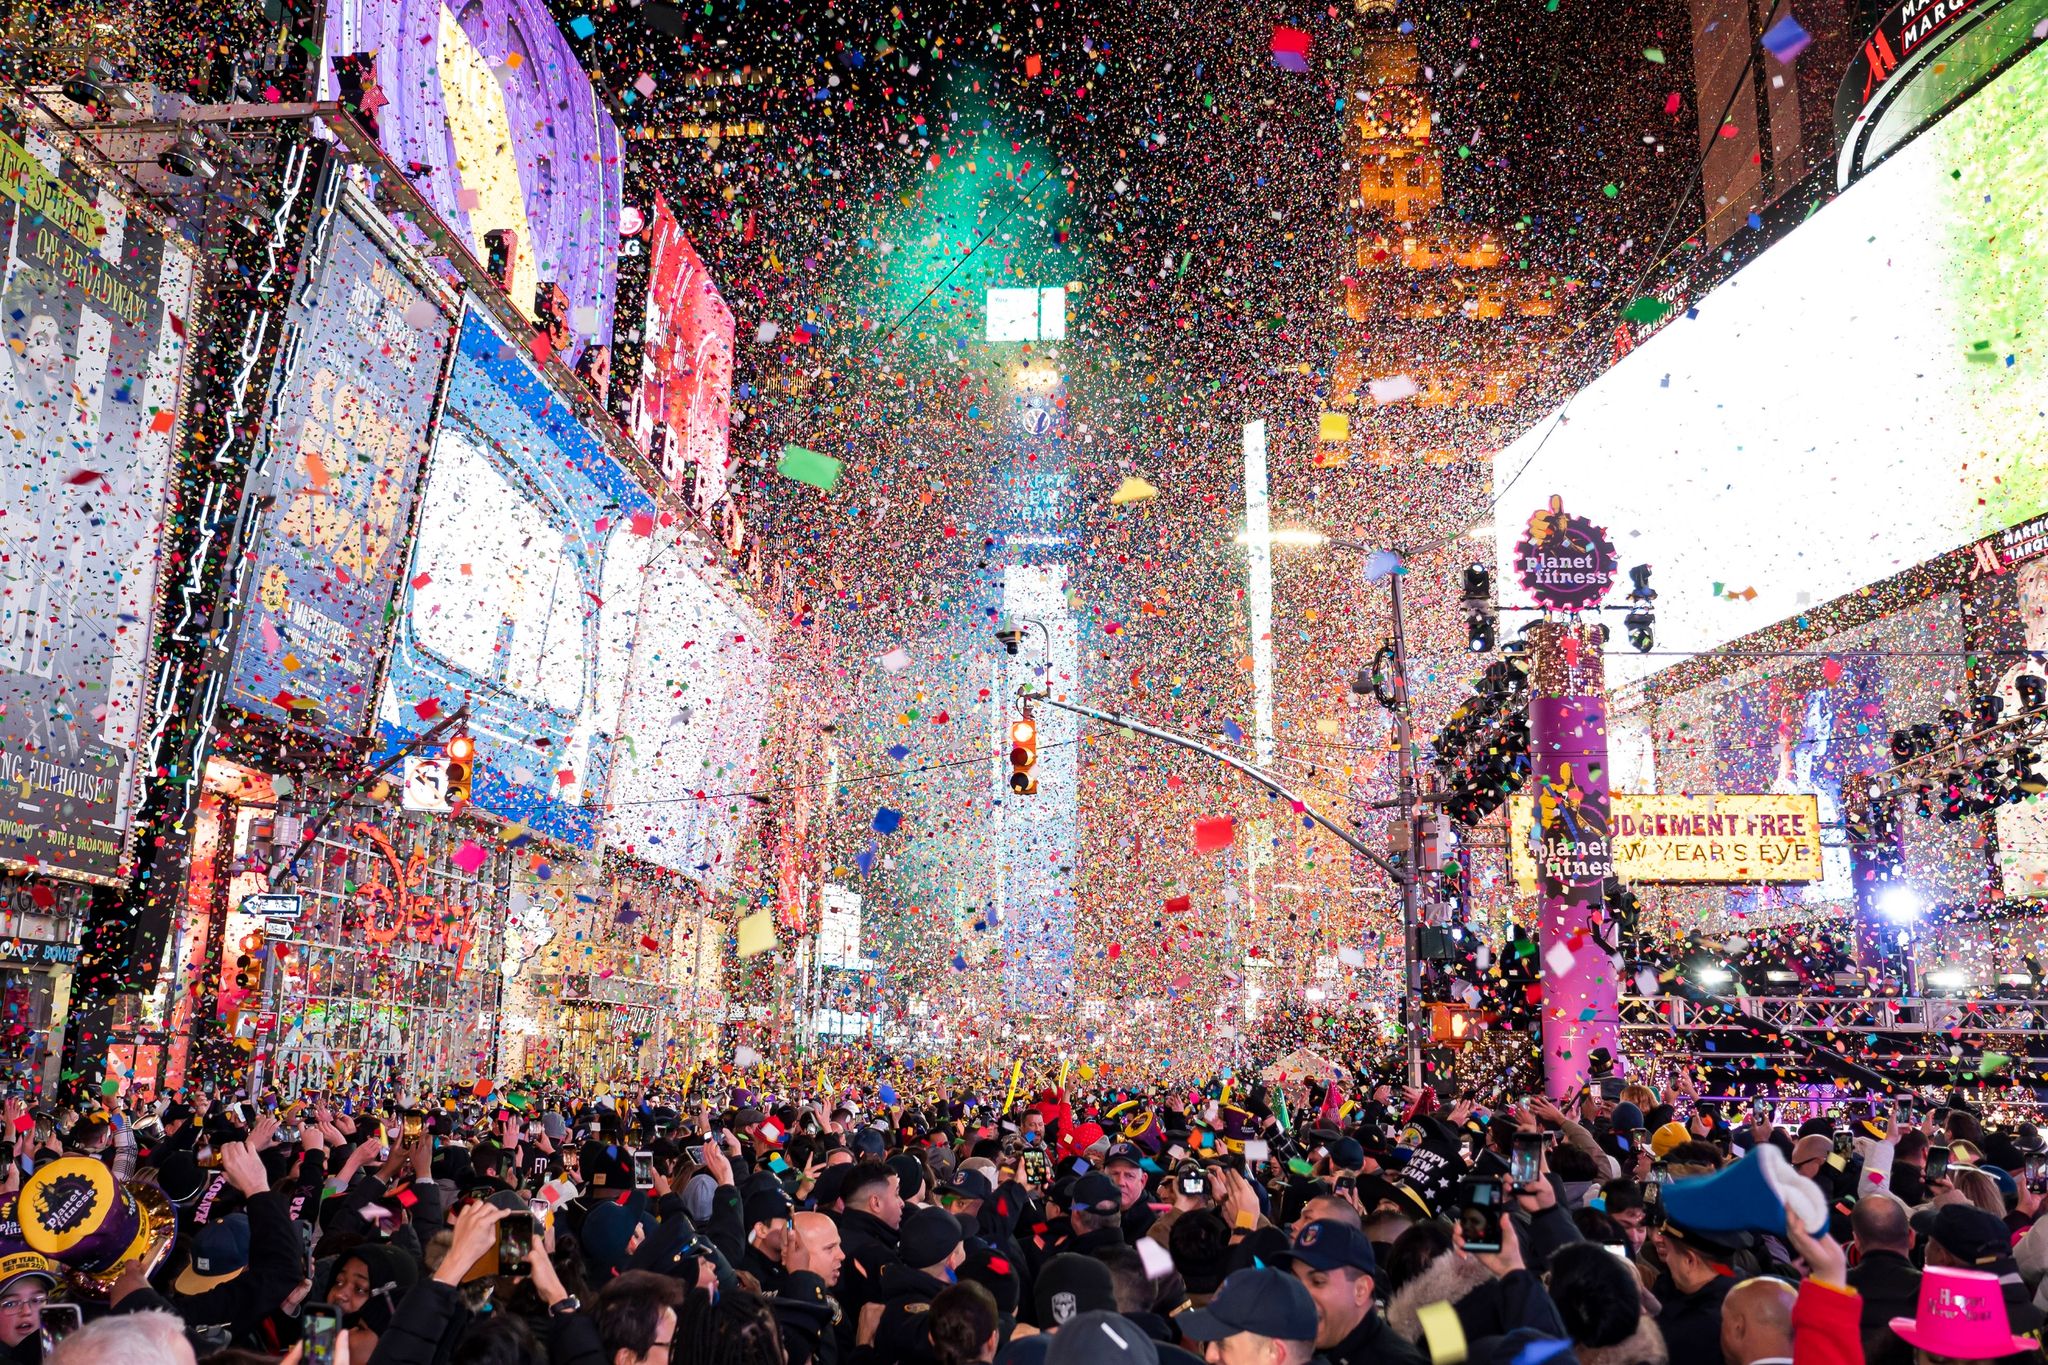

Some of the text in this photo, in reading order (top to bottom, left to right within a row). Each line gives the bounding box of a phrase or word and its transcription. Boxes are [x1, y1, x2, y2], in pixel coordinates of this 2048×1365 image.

[36, 227, 59, 268] ON
[276, 471, 390, 591] AWAY
[1525, 552, 1593, 572] planet
[1535, 568, 1608, 585] fitness
[1747, 814, 1807, 837] FREE
[1657, 843, 1748, 862] YEAR'S
[1759, 844, 1809, 863] EVE
[47, 1189, 83, 1229] planet
[57, 1188, 96, 1229] fitness
